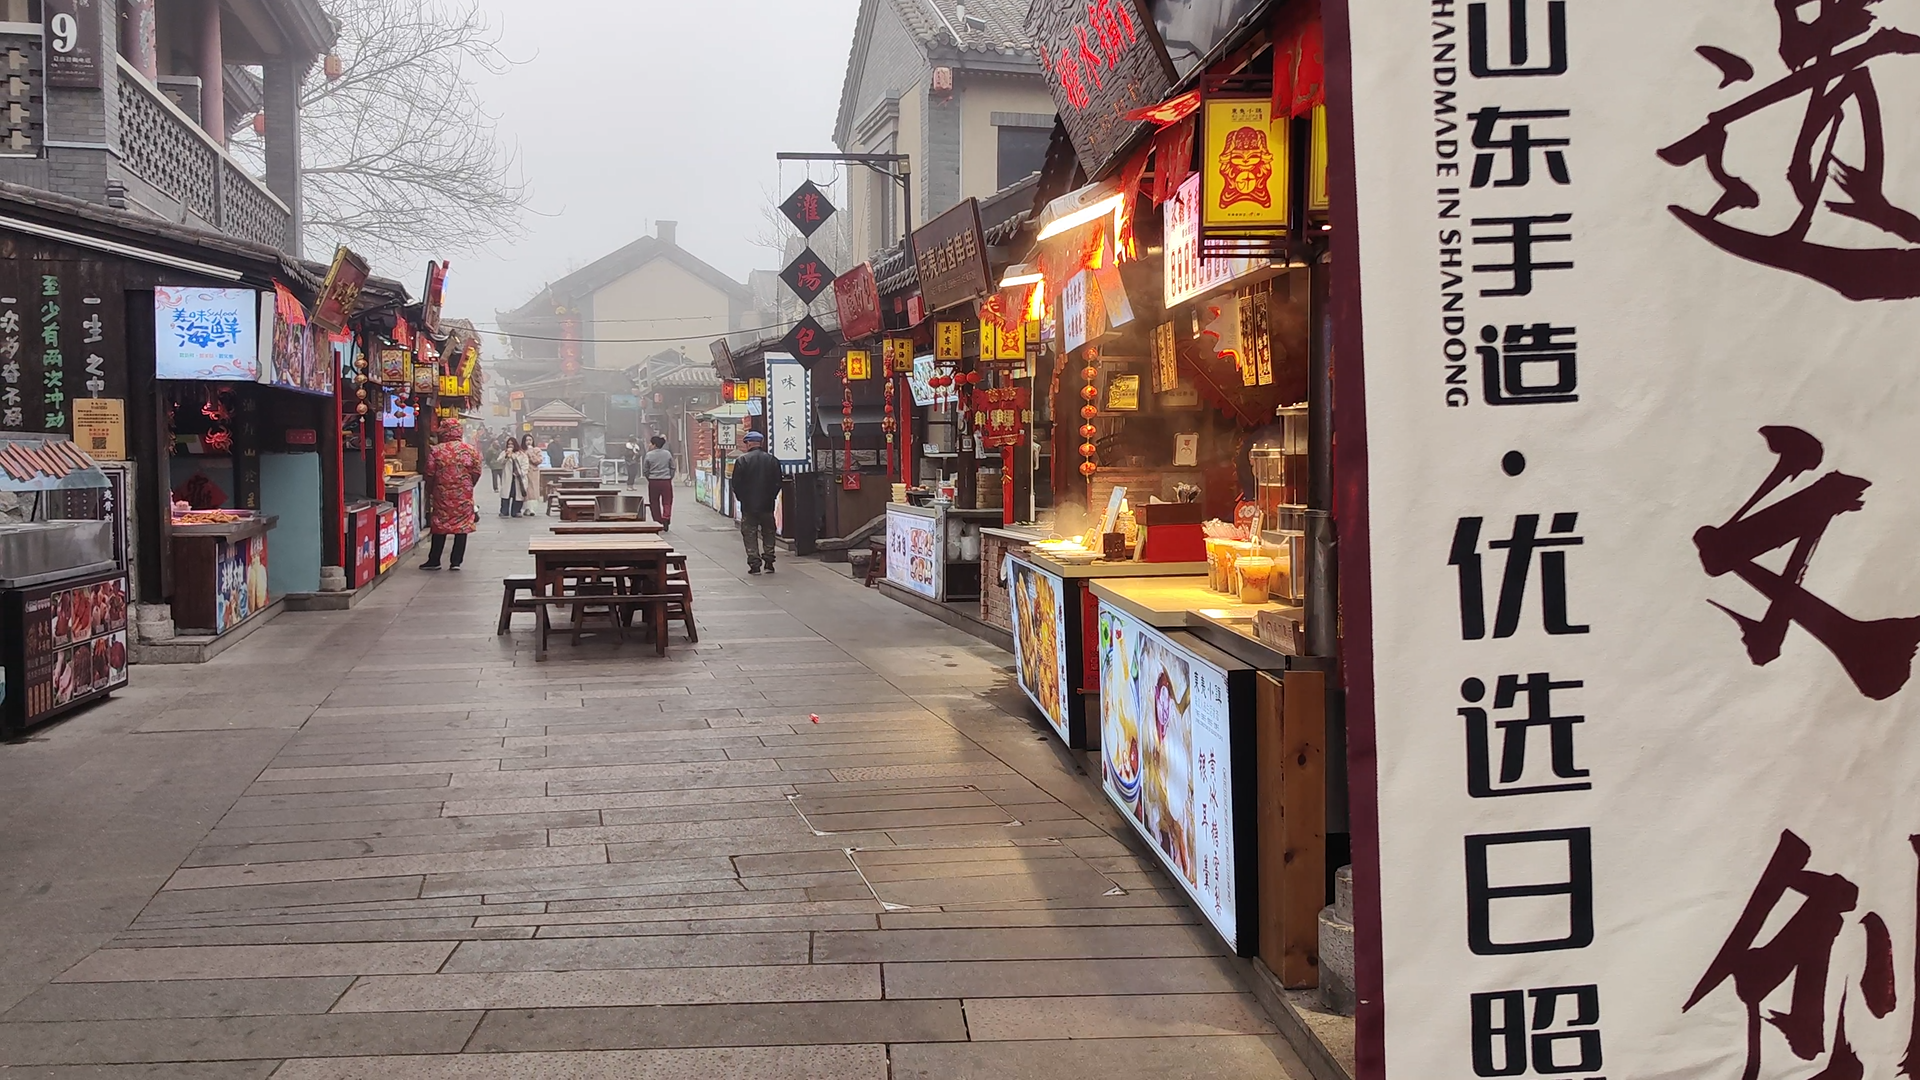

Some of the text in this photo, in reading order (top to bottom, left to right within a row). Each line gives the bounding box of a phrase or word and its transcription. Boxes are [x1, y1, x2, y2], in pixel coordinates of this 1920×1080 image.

[51, 13, 77, 53] 9
[1431, 0, 1469, 408] HANDMADE IN SHANDONG
[172, 307, 209, 323] 美味
[174, 317, 242, 348] 海鲜
[82, 297, 105, 399] 一生之中
